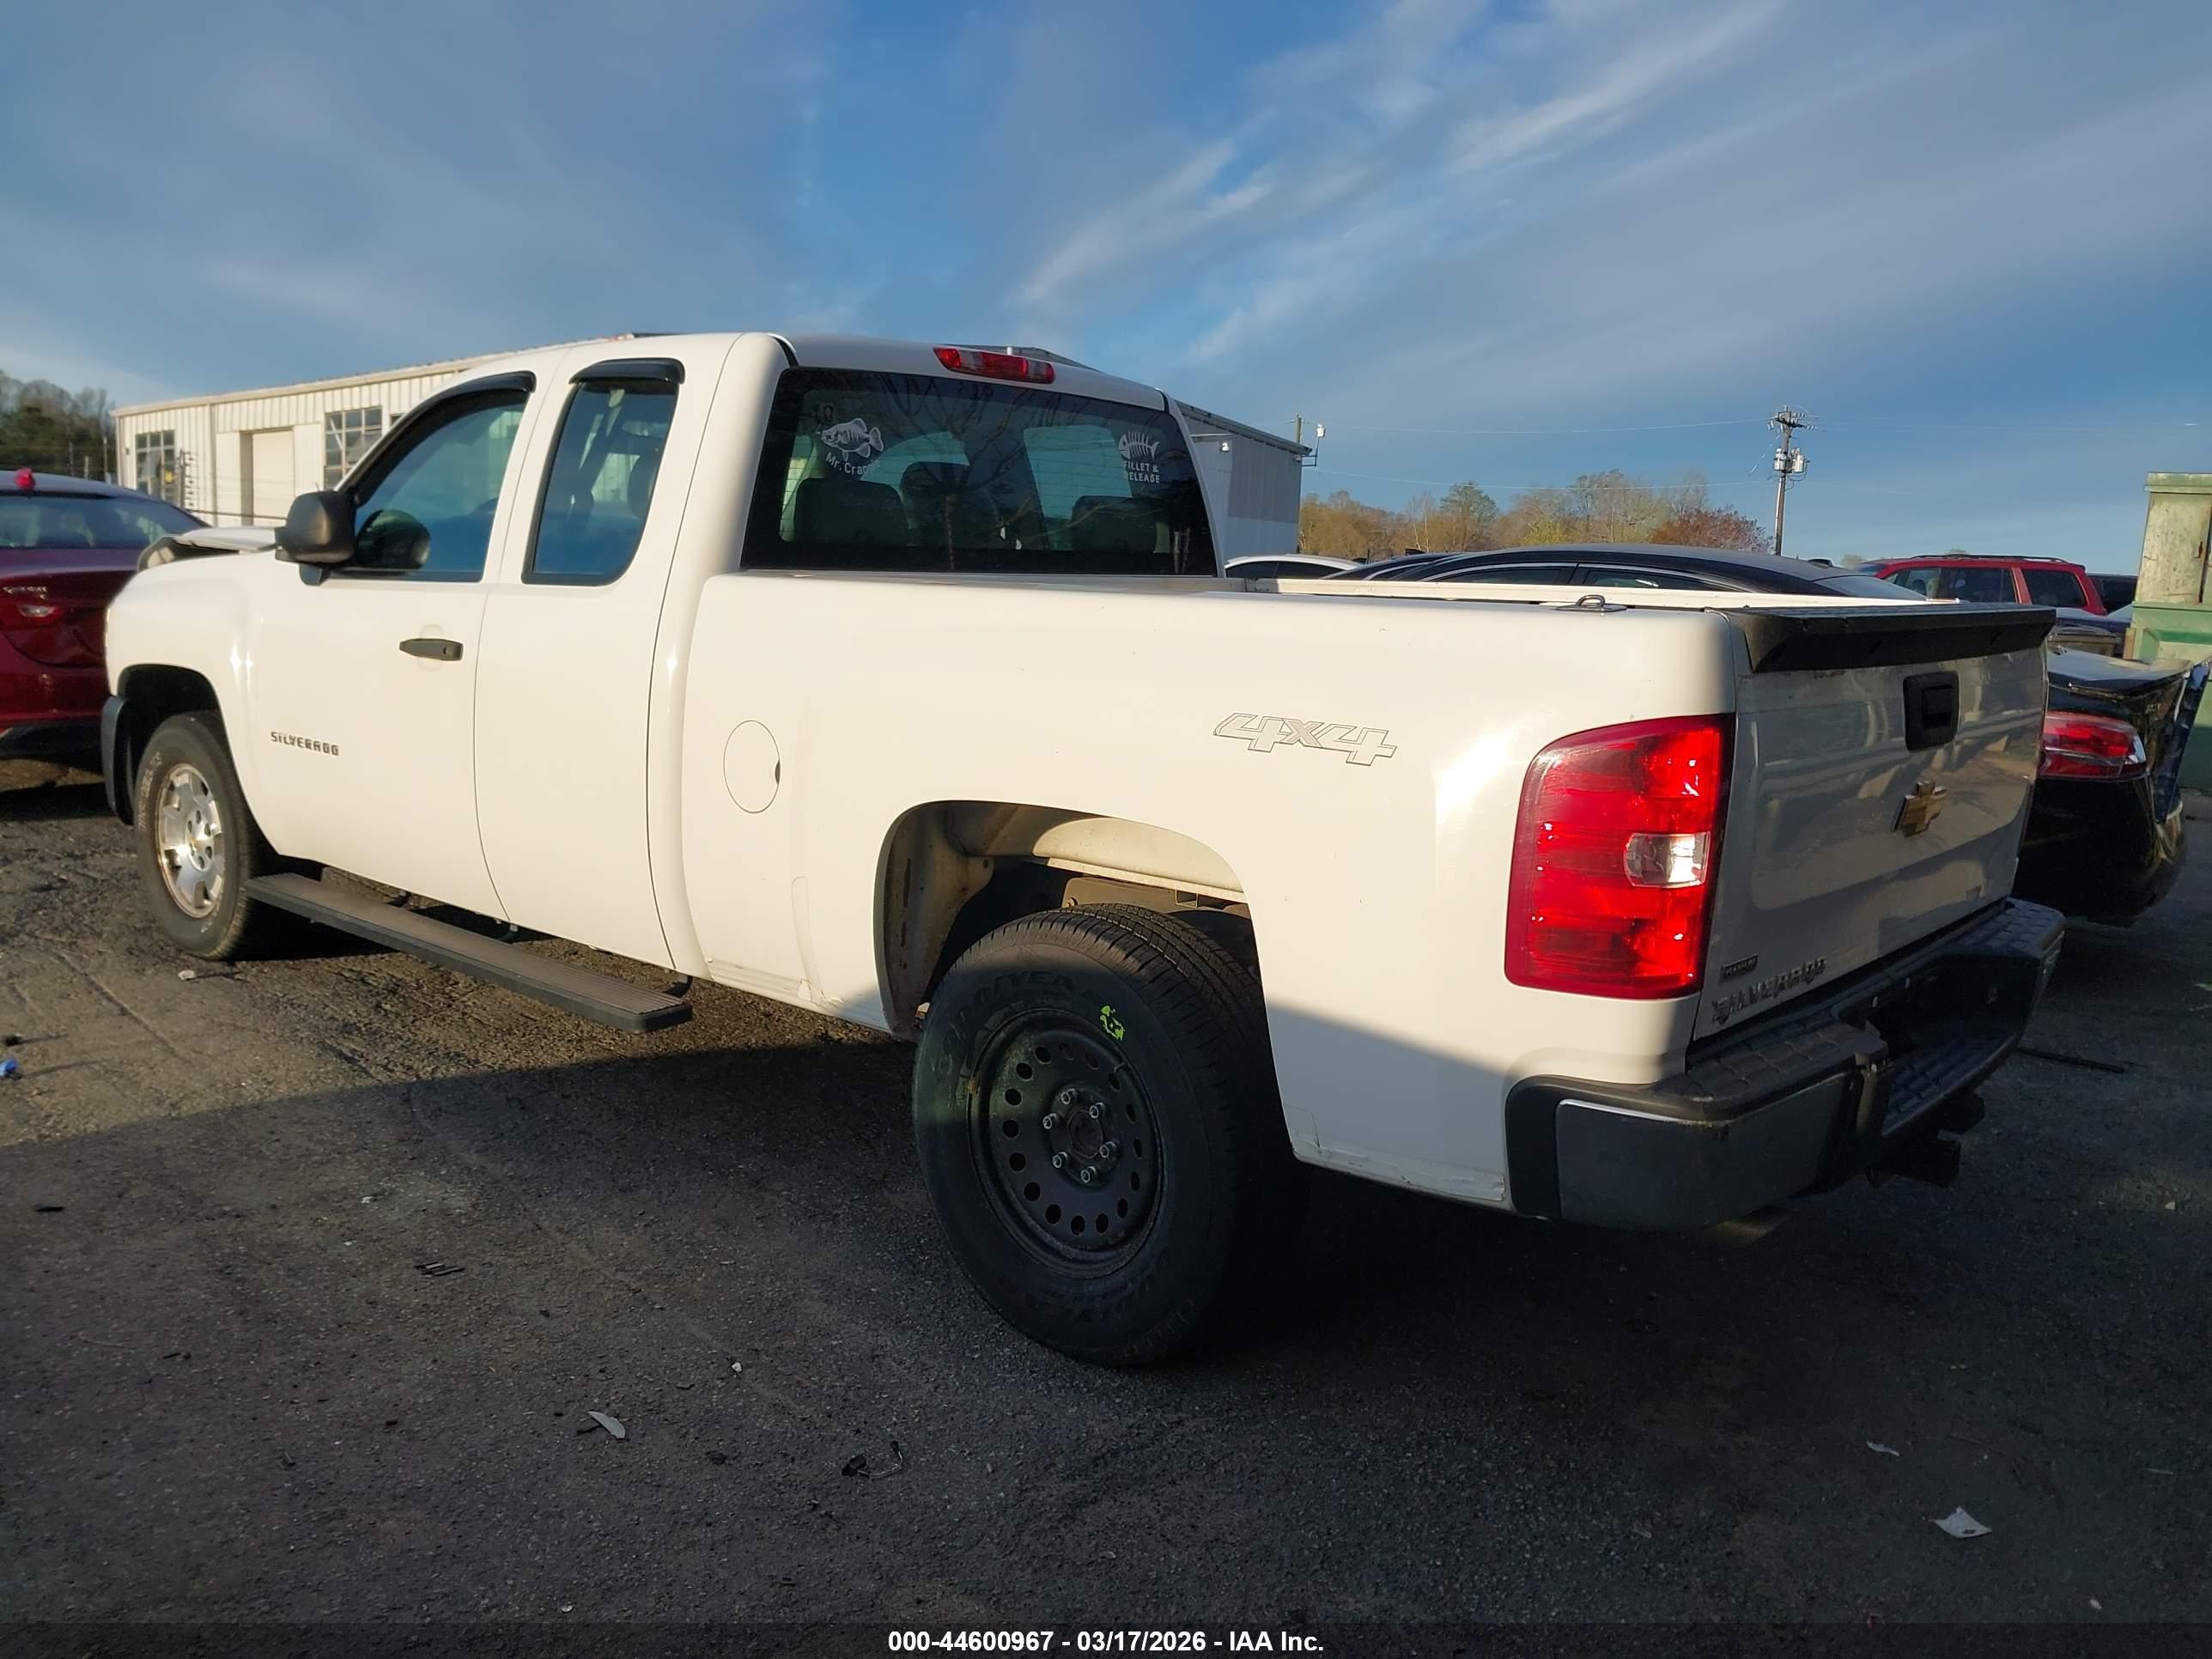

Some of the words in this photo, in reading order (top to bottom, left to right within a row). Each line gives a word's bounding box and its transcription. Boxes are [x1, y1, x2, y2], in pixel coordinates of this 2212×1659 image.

[825, 452, 842, 471] Mr.
[1122, 460, 1150, 472] FILLET
[1152, 465, 1160, 473] &
[270, 731, 339, 757] SILVERADO
